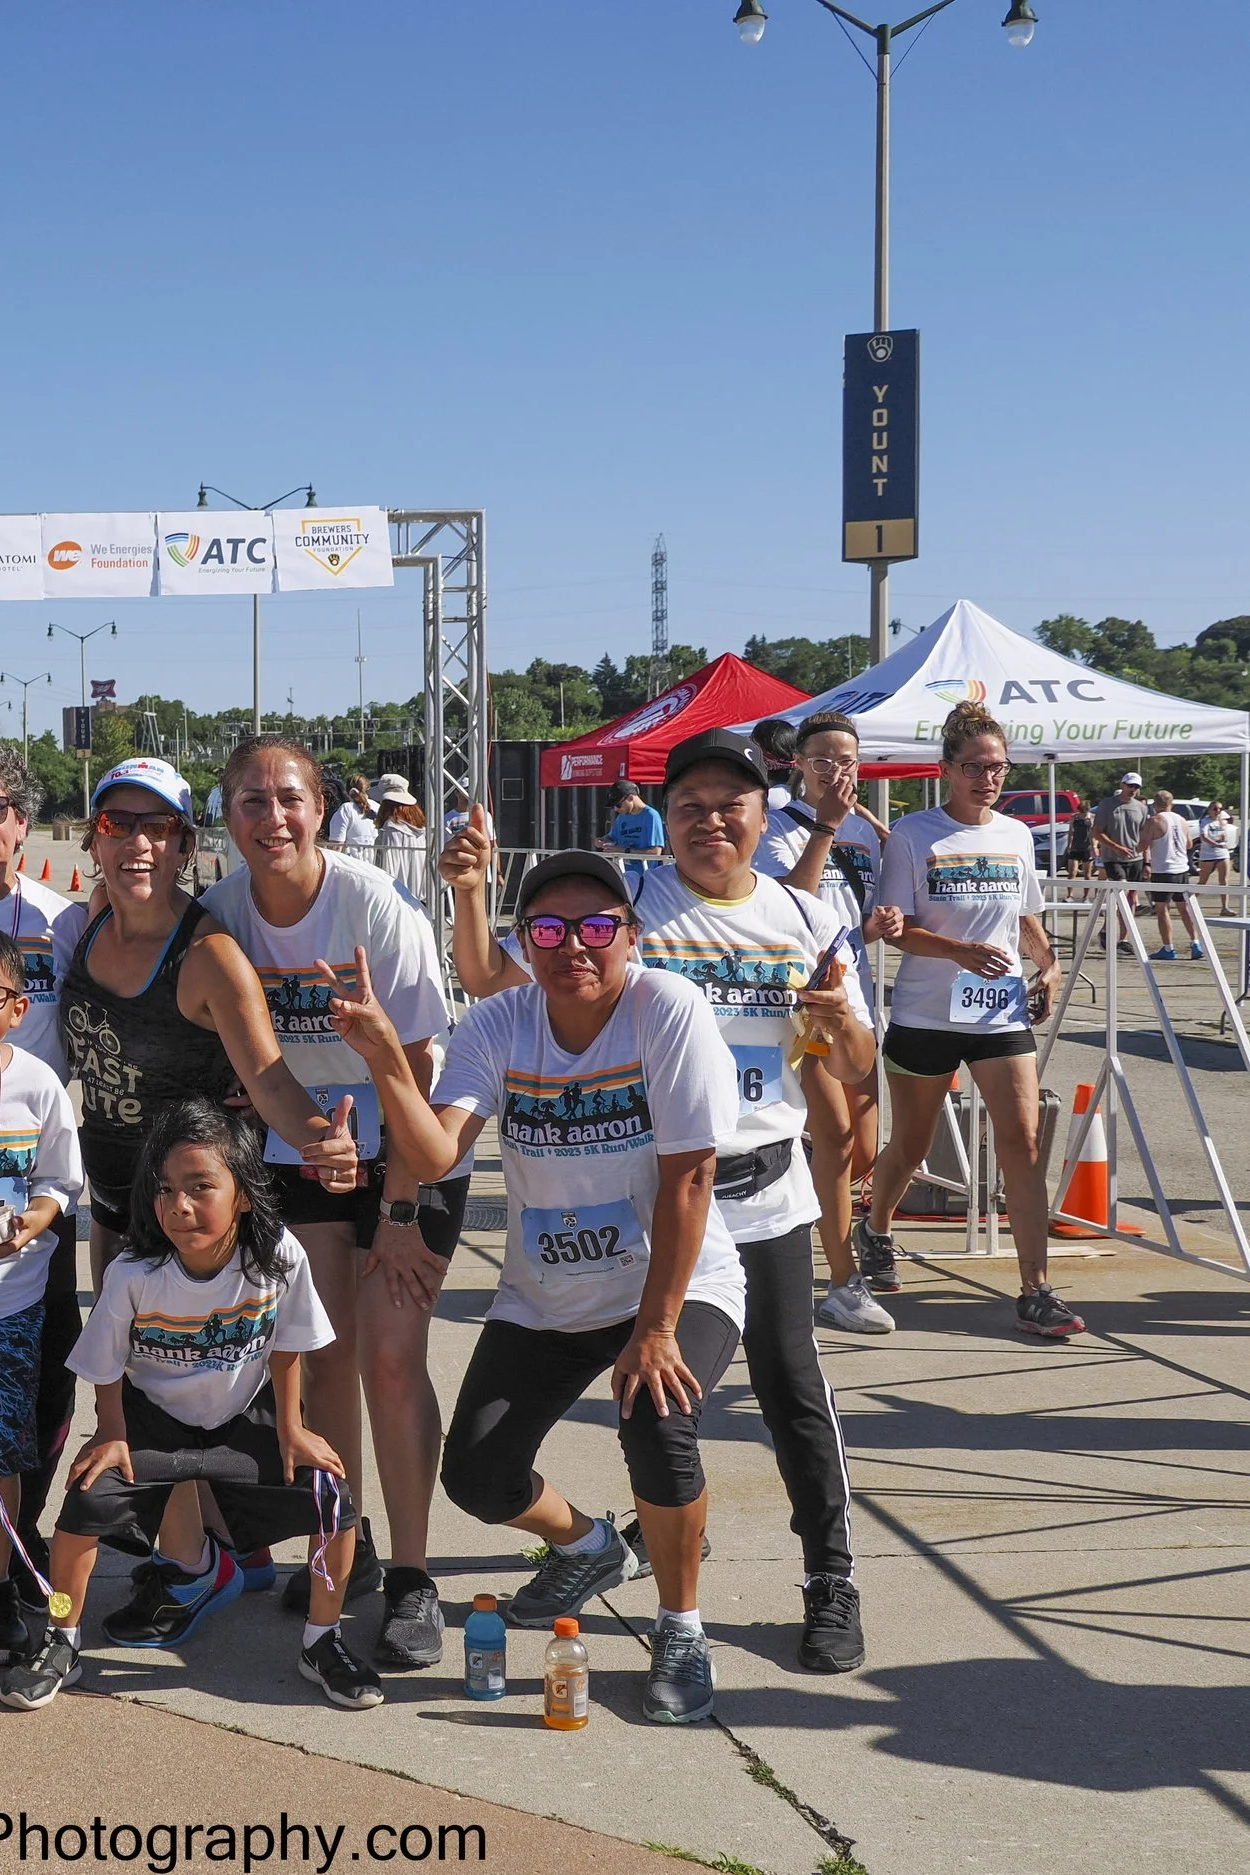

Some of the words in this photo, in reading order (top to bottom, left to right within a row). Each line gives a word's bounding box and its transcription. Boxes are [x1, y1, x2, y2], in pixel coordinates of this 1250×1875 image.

[871, 384, 889, 496] YOUNT
[295, 533, 370, 547] COMMUNITY
[311, 525, 352, 535] BREWERS
[875, 524, 883, 553] 1
[90, 544, 108, 555] We
[110, 543, 153, 557] Energies
[200, 537, 267, 565] ATC
[91, 557, 149, 569] Foundation
[998, 679, 1106, 706] ATC
[1054, 718, 1107, 741] Your
[1113, 717, 1193, 740] Future
[934, 879, 978, 894] hank
[978, 880, 1019, 894] aaron
[726, 986, 798, 1005] aaron
[960, 986, 1009, 1010] 3496
[713, 1007, 740, 1017] 2023
[743, 1007, 759, 1017] 5K
[278, 1034, 301, 1044] 2023
[301, 1034, 317, 1044] 5K
[317, 1033, 343, 1044] Run/
[507, 1116, 563, 1145] hank
[566, 1114, 643, 1144] aaron
[521, 1145, 545, 1158] Trail
[555, 1146, 582, 1157] 2023
[584, 1144, 601, 1156] 5K
[601, 1132, 655, 1154] Run/Walk
[537, 1225, 627, 1265] 3502
[133, 1339, 201, 1361] hank
